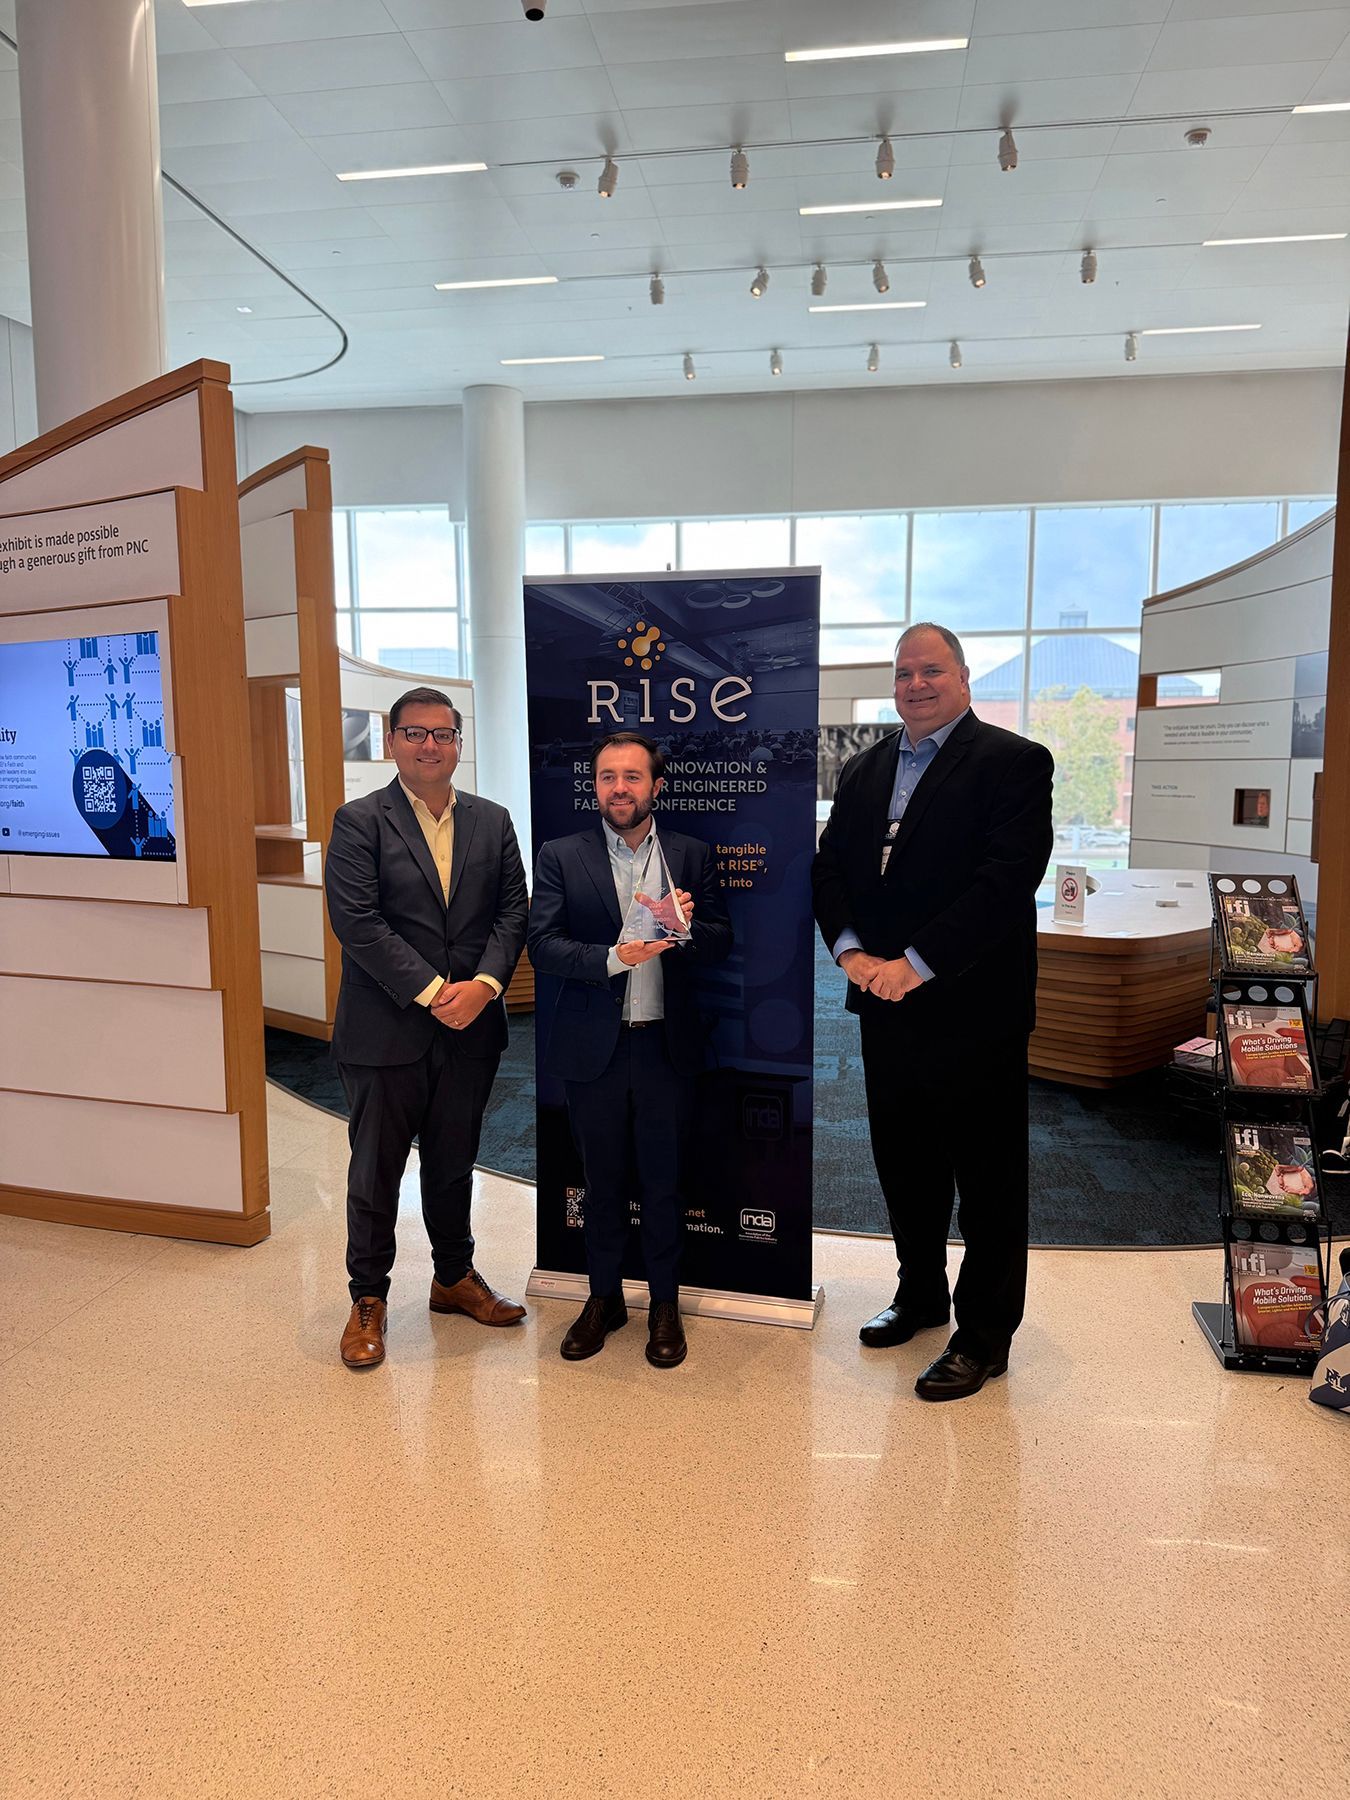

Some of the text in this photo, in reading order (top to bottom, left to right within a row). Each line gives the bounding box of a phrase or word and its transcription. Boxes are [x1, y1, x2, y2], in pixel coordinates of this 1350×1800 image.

[34, 535, 43, 548] is
[45, 531, 75, 547] made
[77, 524, 119, 546] possible
[18, 558, 25, 568] a
[27, 552, 76, 571] generous
[78, 545, 96, 565] gift
[98, 545, 124, 559] from
[126, 539, 149, 555] PNC
[0, 727, 17, 744] ity
[573, 761, 767, 774] RE NNOVATION &
[661, 780, 669, 792] R
[673, 780, 767, 793] ENGINEERED
[0, 800, 25, 809] org/faith
[574, 799, 736, 811] FAB ONFERENCE
[716, 843, 767, 857] tangible
[720, 877, 753, 887] s into
[1242, 1036, 1292, 1046] What's Driving
[1241, 1043, 1298, 1053] Mobile Solutions
[629, 1201, 640, 1211] it:
[685, 1209, 705, 1218] .net
[1241, 1253, 1266, 1276] ifj
[1254, 1287, 1307, 1296] What's Driving
[1253, 1294, 1312, 1305] Mobile Solutions
